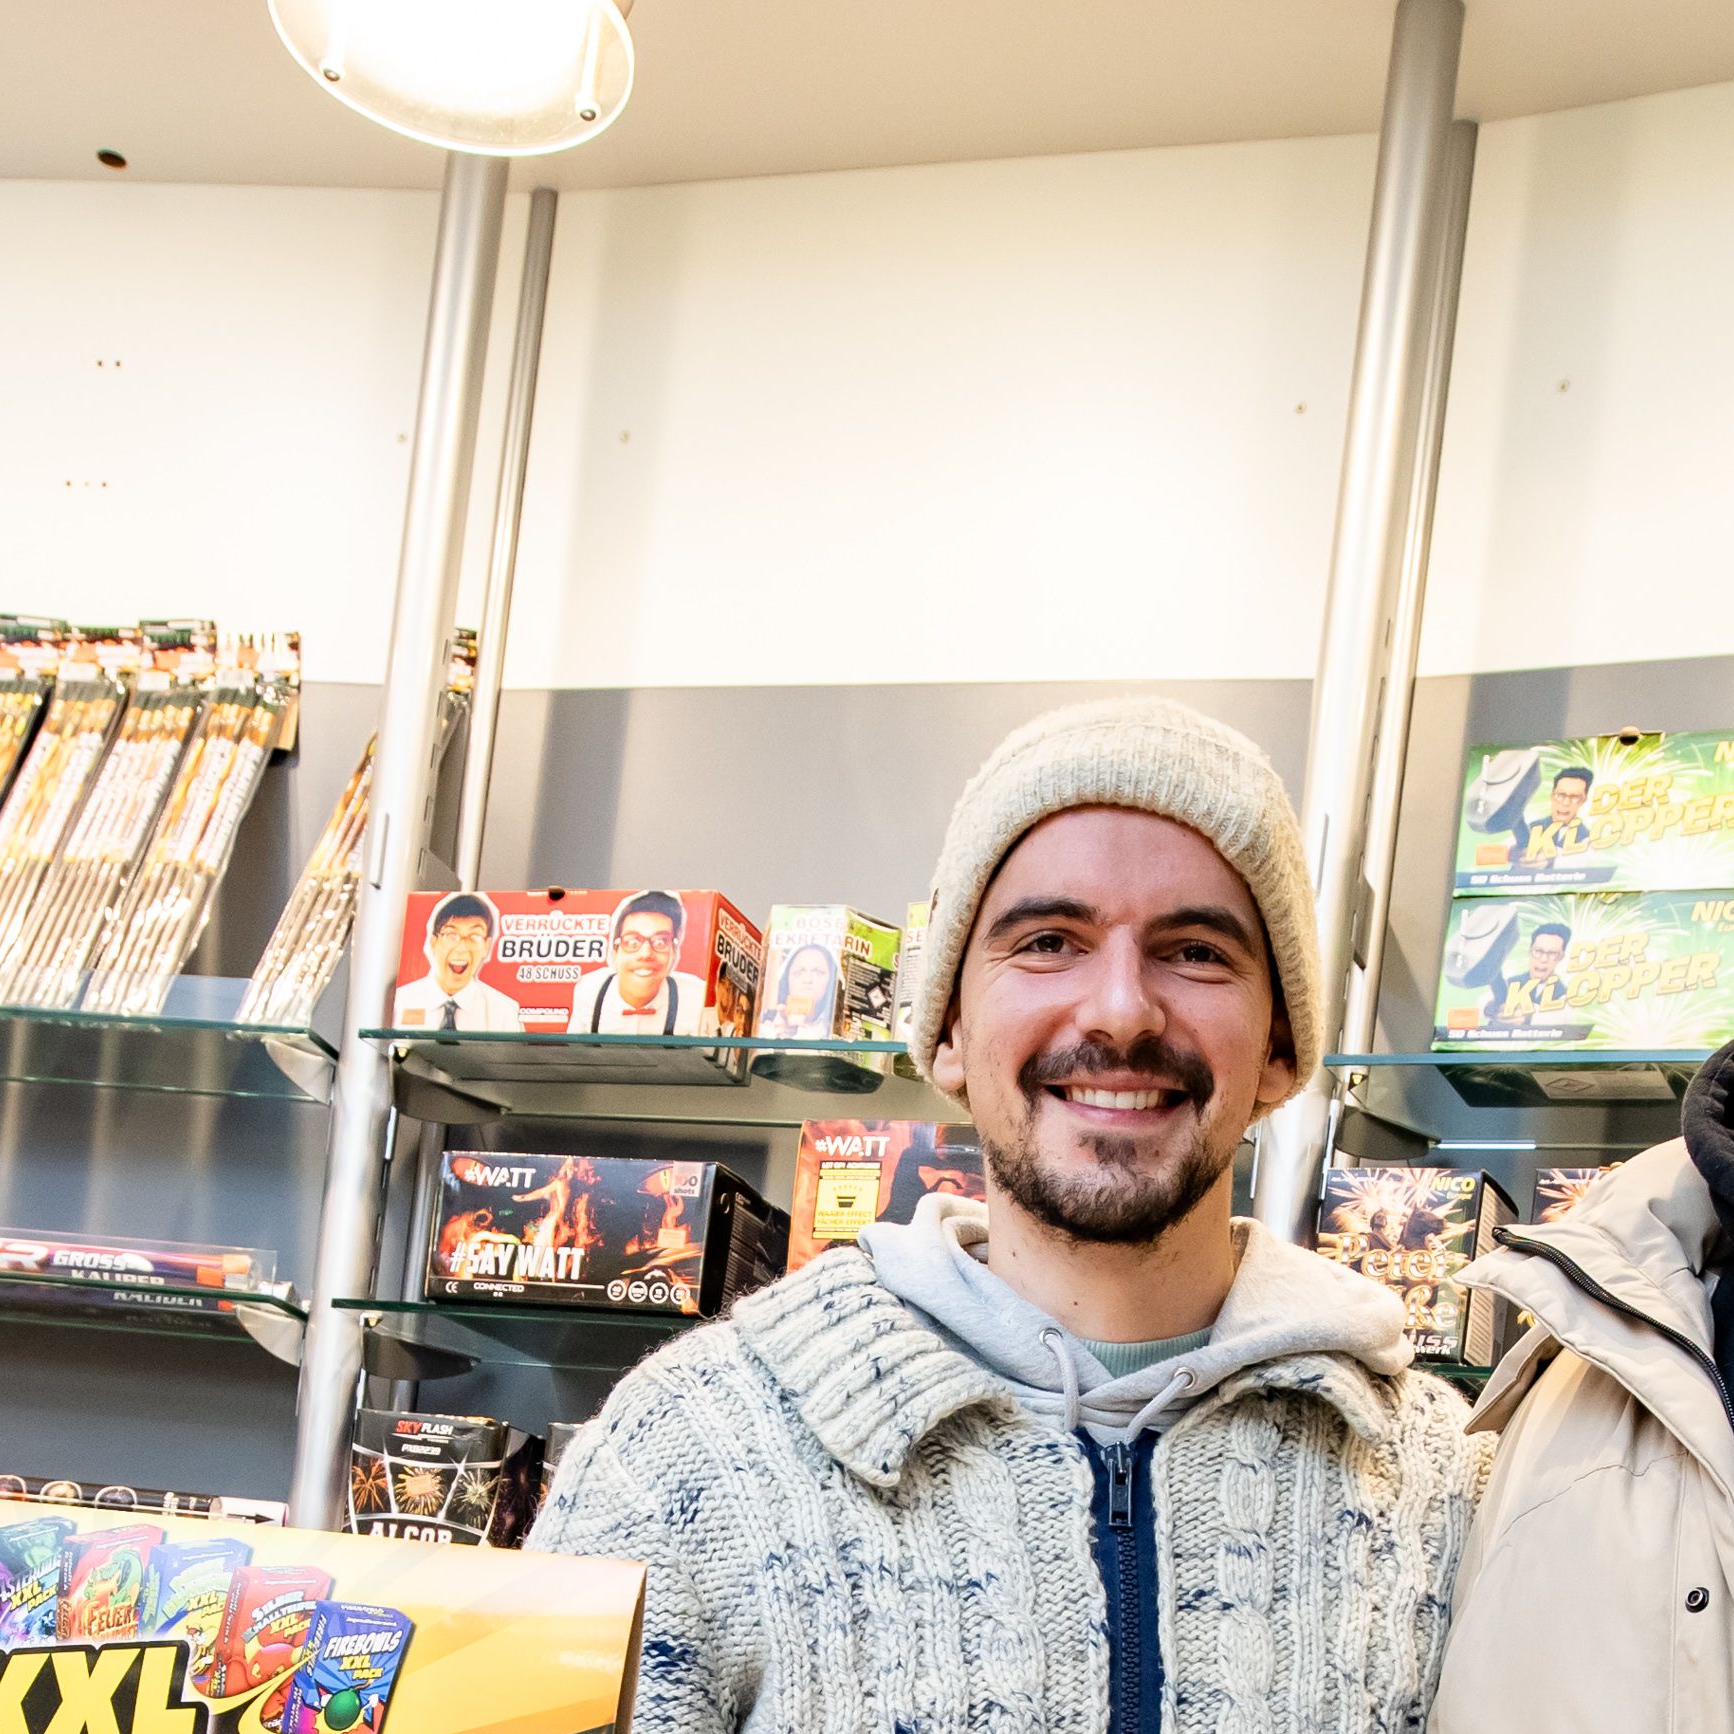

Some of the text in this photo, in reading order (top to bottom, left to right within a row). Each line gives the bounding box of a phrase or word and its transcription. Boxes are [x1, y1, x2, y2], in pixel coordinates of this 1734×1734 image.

[1592, 773, 1673, 816] DER
[505, 909, 607, 933] VERRÜCKTE
[500, 933, 604, 959] BRÜDER
[1568, 931, 1649, 973] DER
[517, 966, 580, 982] 48 SCHUSS
[1501, 951, 1721, 1019] KLOPPER
[815, 1136, 890, 1157] #WATT
[464, 1166, 536, 1189] #WATT
[1431, 1176, 1476, 1193] NICO
[51, 1248, 129, 1272] GROSS
[449, 1241, 585, 1279] #SAY WATT
[324, 1629, 402, 1661] FIREBOWLS
[340, 1654, 373, 1673] XXL
